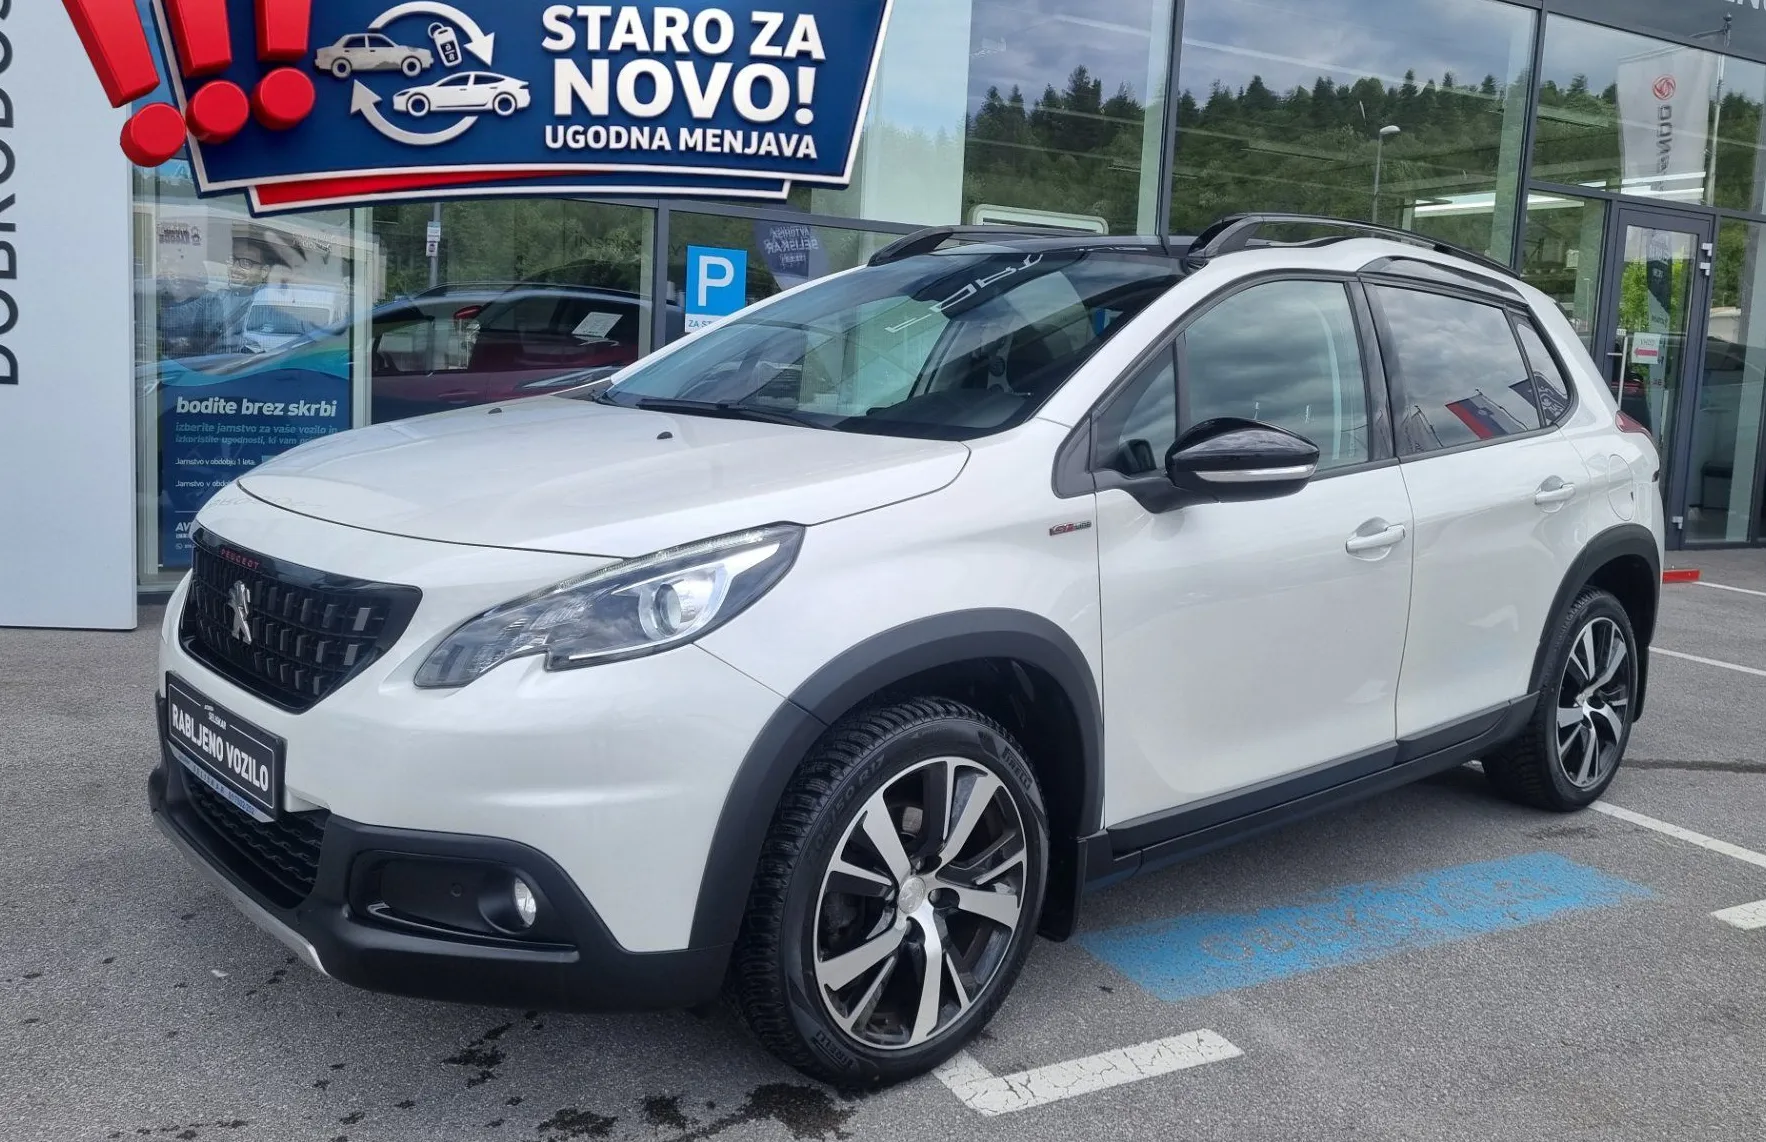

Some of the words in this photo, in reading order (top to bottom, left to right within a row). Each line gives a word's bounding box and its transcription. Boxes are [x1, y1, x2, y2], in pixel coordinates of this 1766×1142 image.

[697, 255, 735, 307] P
[688, 319, 700, 328] ZA
[176, 396, 238, 415] bodite
[241, 399, 285, 416] brez
[288, 400, 338, 418] skrbi
[216, 423, 257, 434] jamstvo
[299, 425, 327, 434] vozilo
[268, 436, 276, 444] ki
[221, 548, 260, 570] PEUGEOT
[171, 703, 224, 762] RABLJENO
[225, 741, 269, 792] VOZILO
